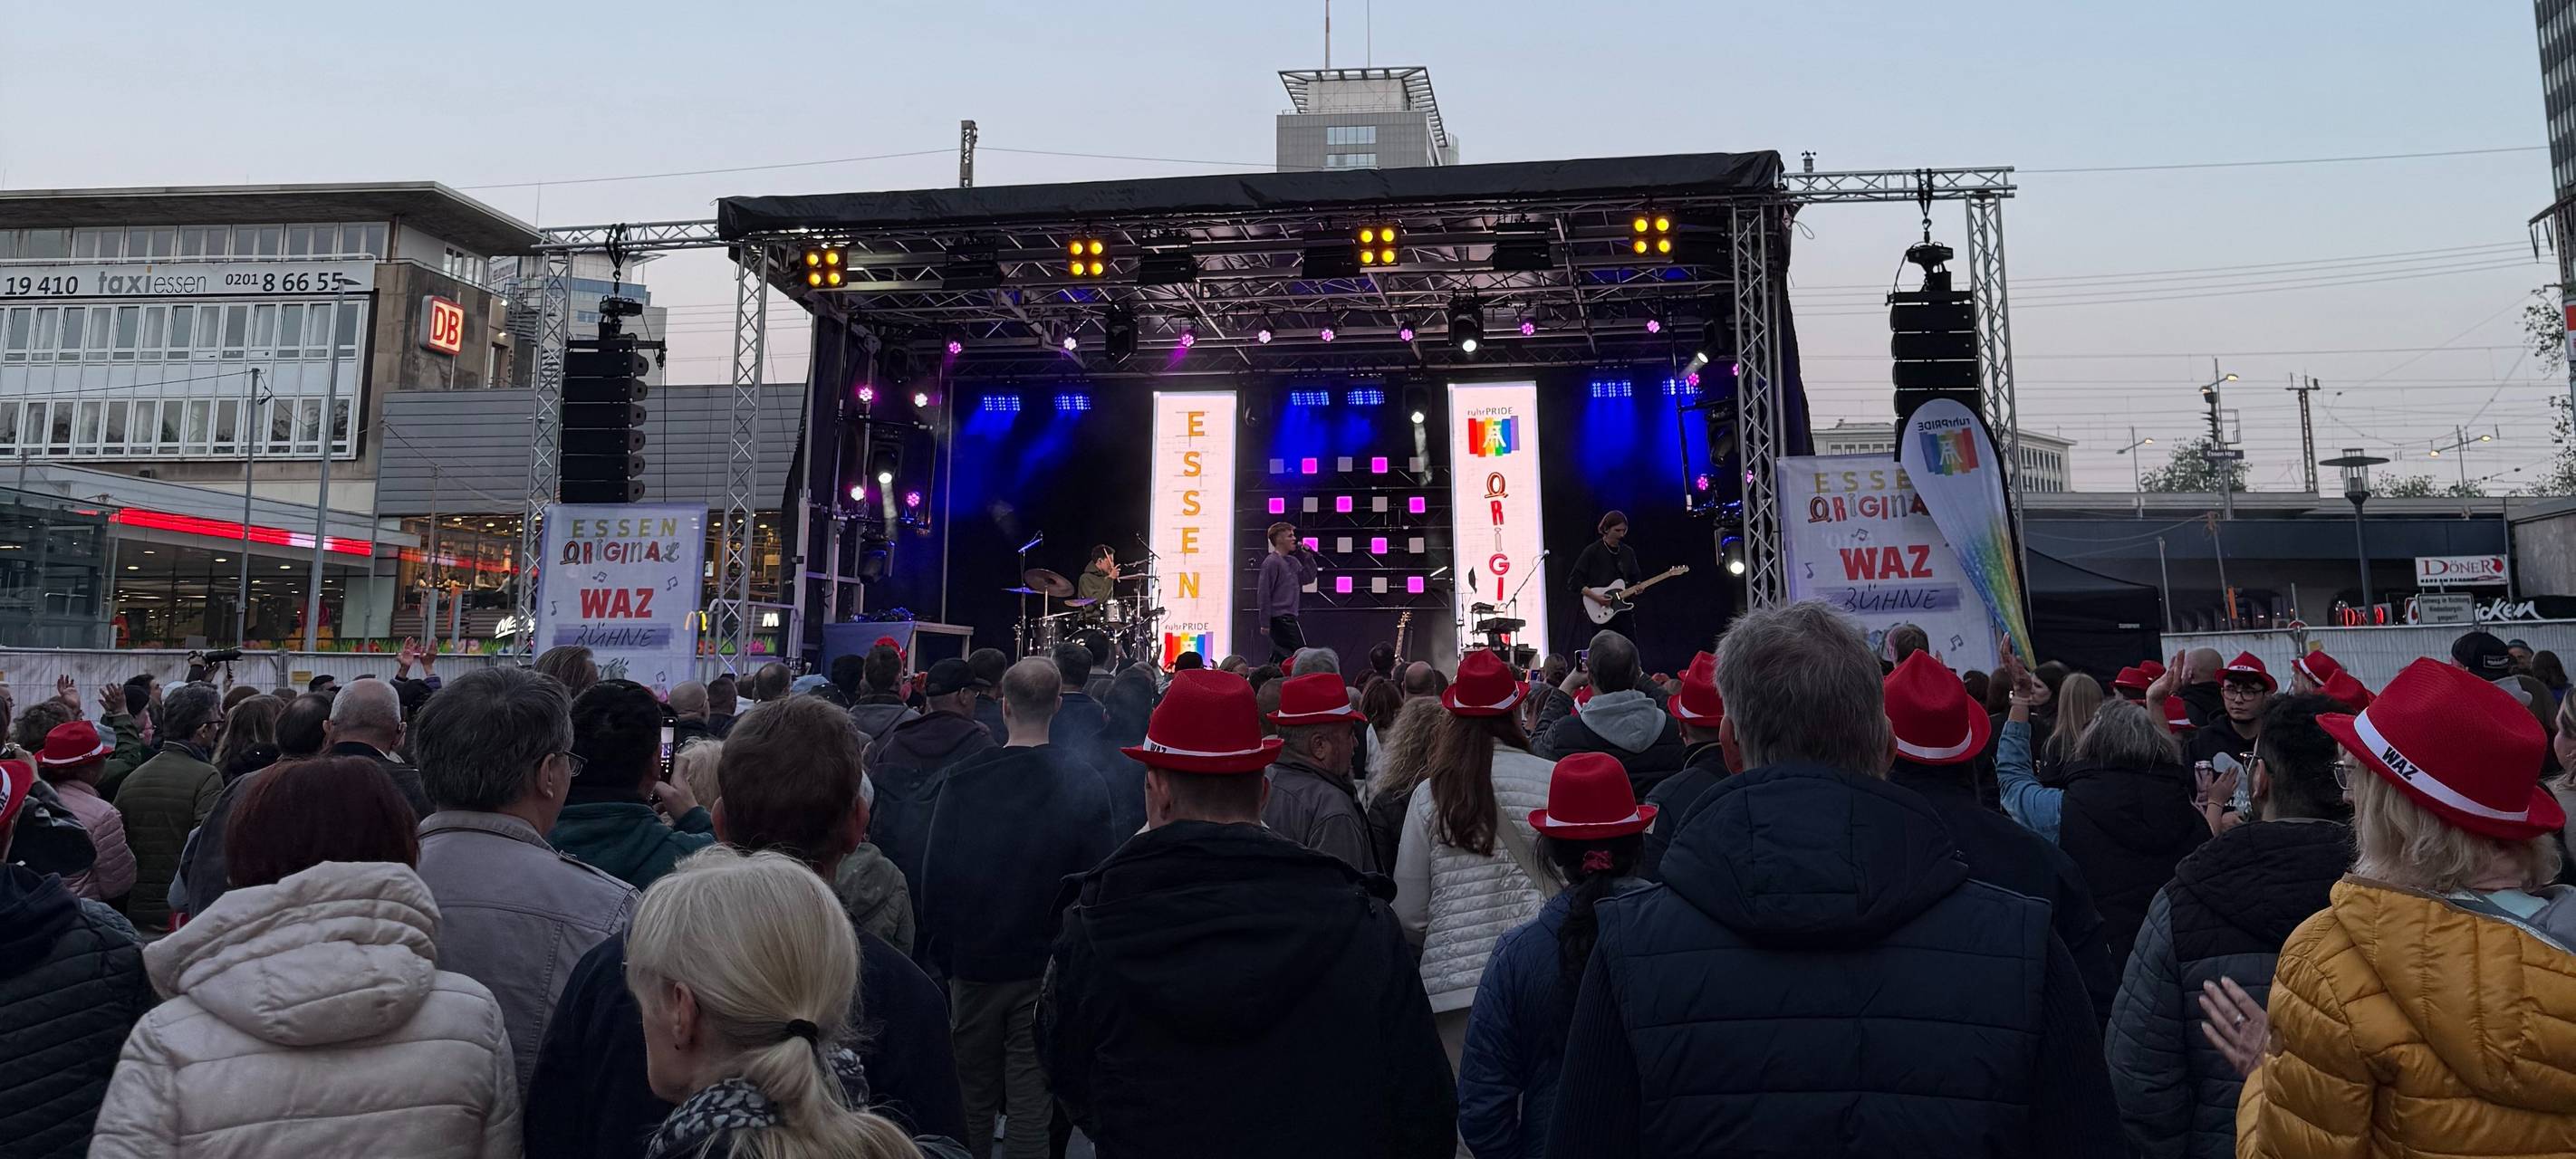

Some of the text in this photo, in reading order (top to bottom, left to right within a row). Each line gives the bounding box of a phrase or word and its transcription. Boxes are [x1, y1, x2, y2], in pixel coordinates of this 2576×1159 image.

[5, 276, 32, 296] 19
[36, 275, 80, 295] 410
[225, 273, 258, 286] 0201
[262, 273, 275, 292] 8
[282, 273, 309, 292] 66
[316, 273, 343, 291] 55
[433, 306, 459, 345] DB
[1814, 470, 1913, 493] ESSE
[1177, 410, 1206, 599] ESSEN
[572, 518, 677, 538] ESSEN
[1840, 545, 1933, 580] WAZ
[580, 589, 655, 618] WAZ
[1845, 584, 1938, 611] BÜHNE
[2407, 598, 2544, 624] Cicken
[573, 622, 656, 648] BÜHNE
[2381, 746, 2419, 781] WAZ
